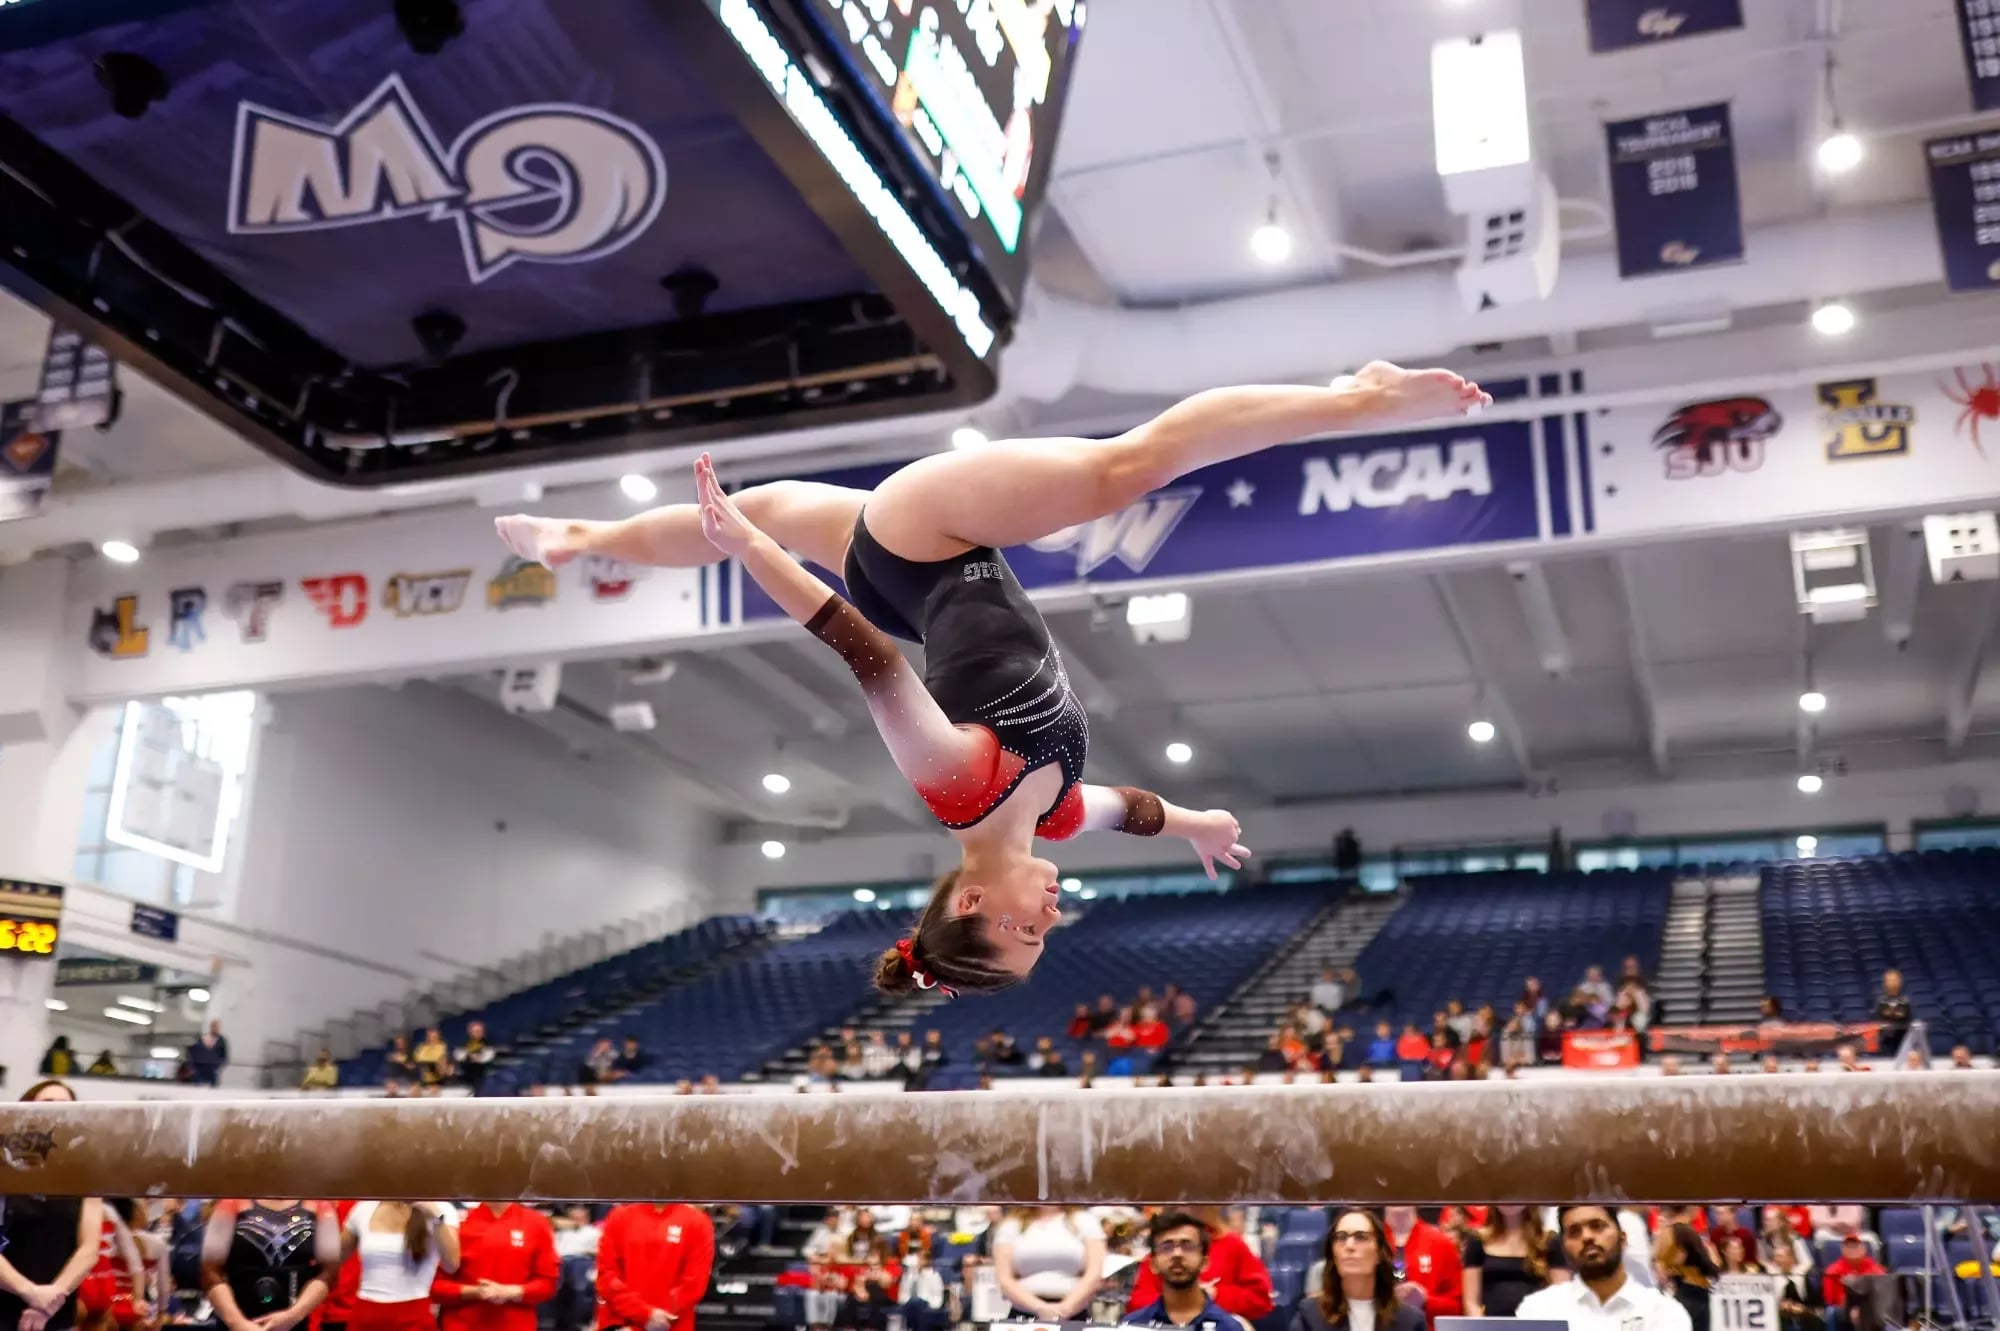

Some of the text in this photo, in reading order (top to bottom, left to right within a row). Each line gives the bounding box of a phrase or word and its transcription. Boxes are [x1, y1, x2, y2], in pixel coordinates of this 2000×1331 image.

[1299, 440, 1492, 515] NCAA
[1663, 436, 1766, 480] SJU
[1721, 1298, 1765, 1329] 112
